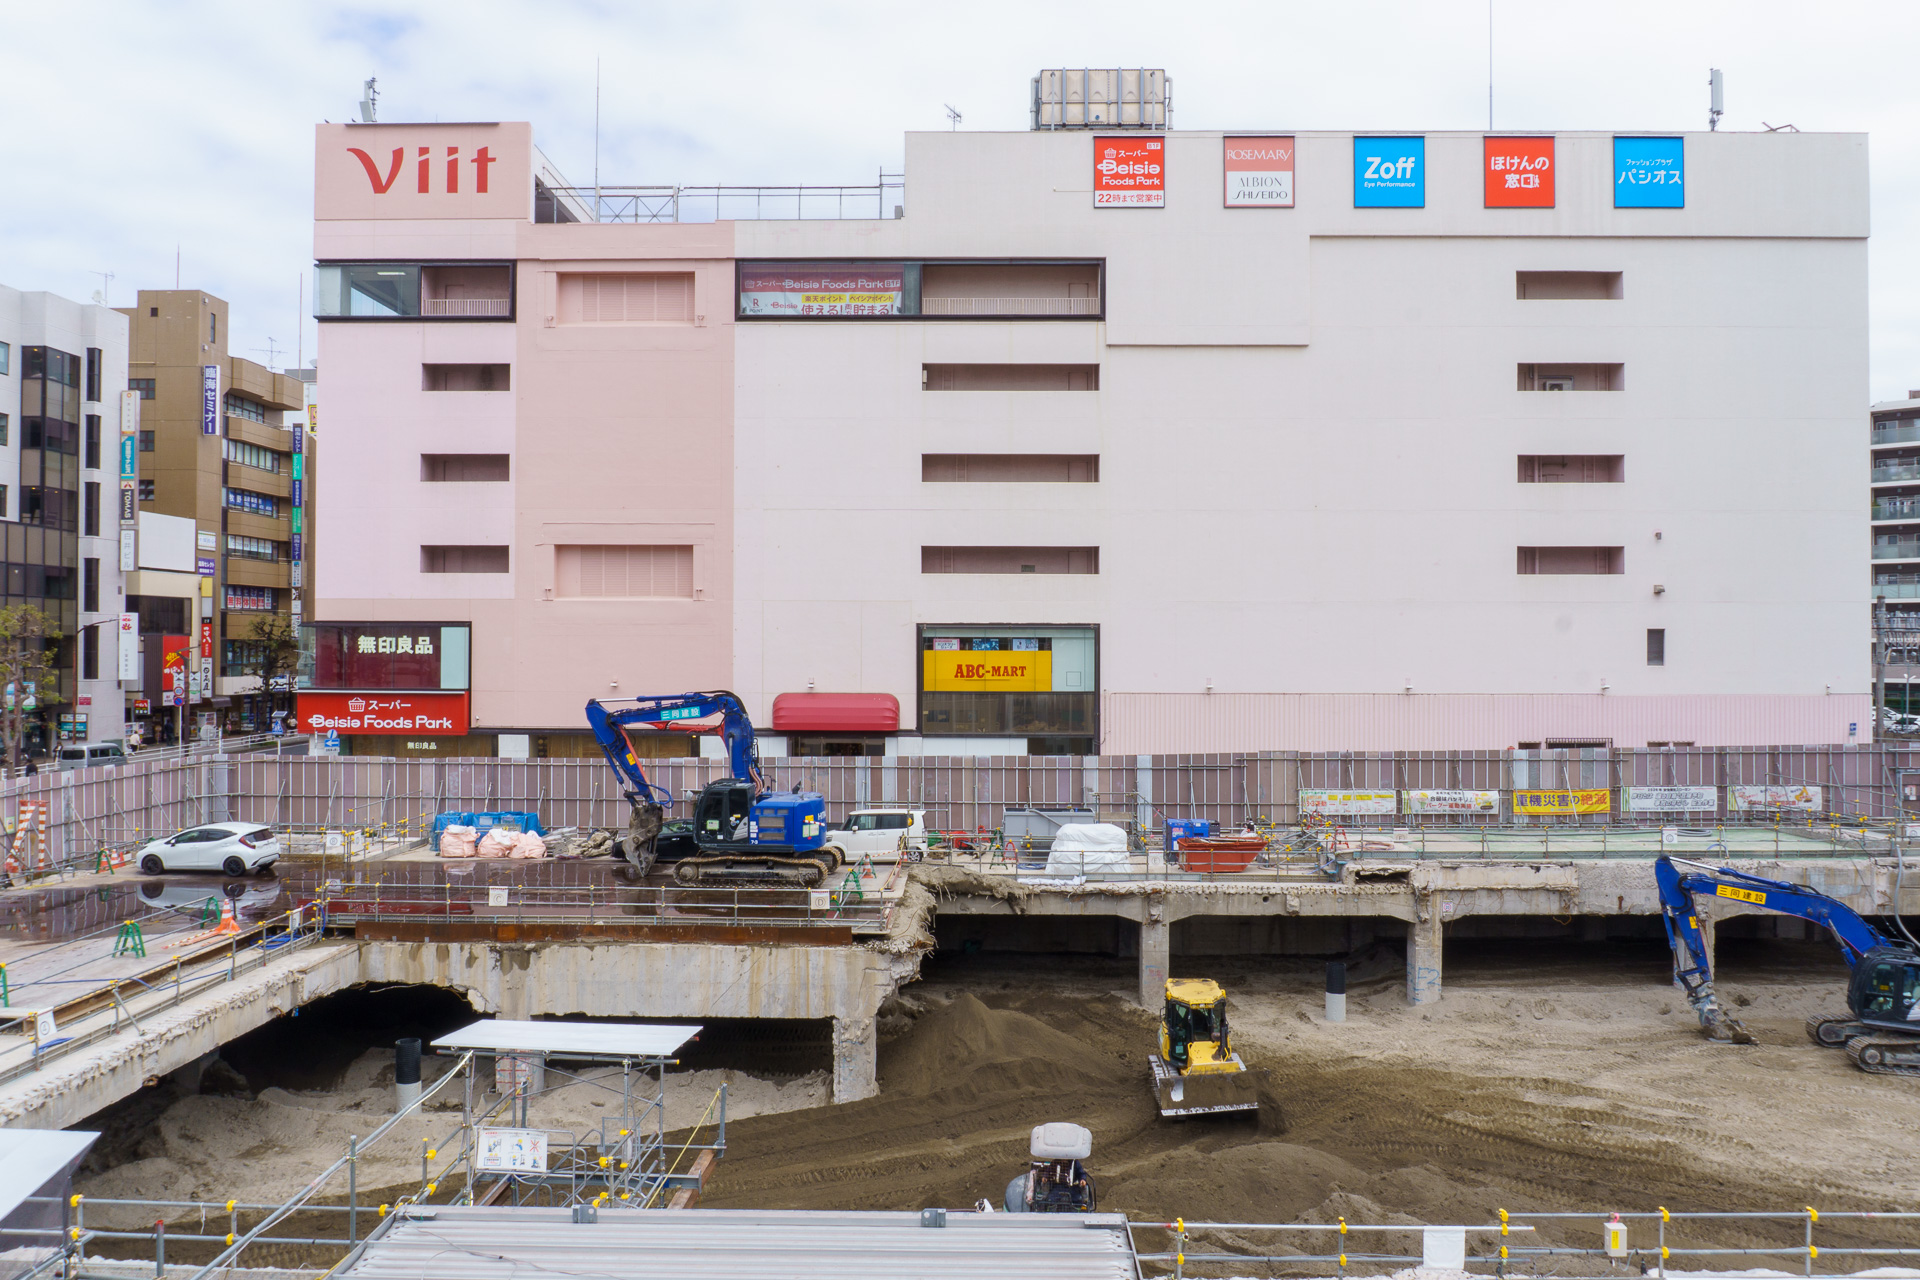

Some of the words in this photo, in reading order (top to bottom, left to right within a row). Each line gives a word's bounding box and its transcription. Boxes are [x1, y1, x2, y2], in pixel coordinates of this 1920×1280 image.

[1118, 150, 1148, 158] スーパー
[1227, 149, 1292, 161] ROSEMARY
[1097, 159, 1160, 175] Beisia
[1364, 157, 1416, 179] Zoff
[1491, 156, 1549, 170] ほけんの
[1626, 158, 1673, 166] ファッションプラザ
[347, 146, 497, 194] Viit
[1618, 168, 1682, 184] パシオス
[1103, 176, 1134, 185] Foods
[1136, 176, 1160, 185] Park
[1238, 177, 1282, 187] ALBION
[1505, 173, 1533, 188] 窓口
[1098, 193, 1162, 203] 22時まで営業中
[1232, 190, 1288, 199] SHISEIDO
[782, 279, 819, 289] Beisia
[822, 279, 855, 289] Foods
[858, 279, 883, 288] Park
[205, 368, 216, 433] 臨海セミナー
[358, 635, 433, 654] 無印良品
[954, 664, 1027, 679] ABC-MART
[368, 700, 411, 710] スーパー
[308, 715, 361, 728] Beisia
[364, 715, 413, 728] Foods
[416, 715, 452, 729] Park
[407, 742, 437, 750] 無印良品
[1516, 793, 1607, 806] 重機災害の絶滅
